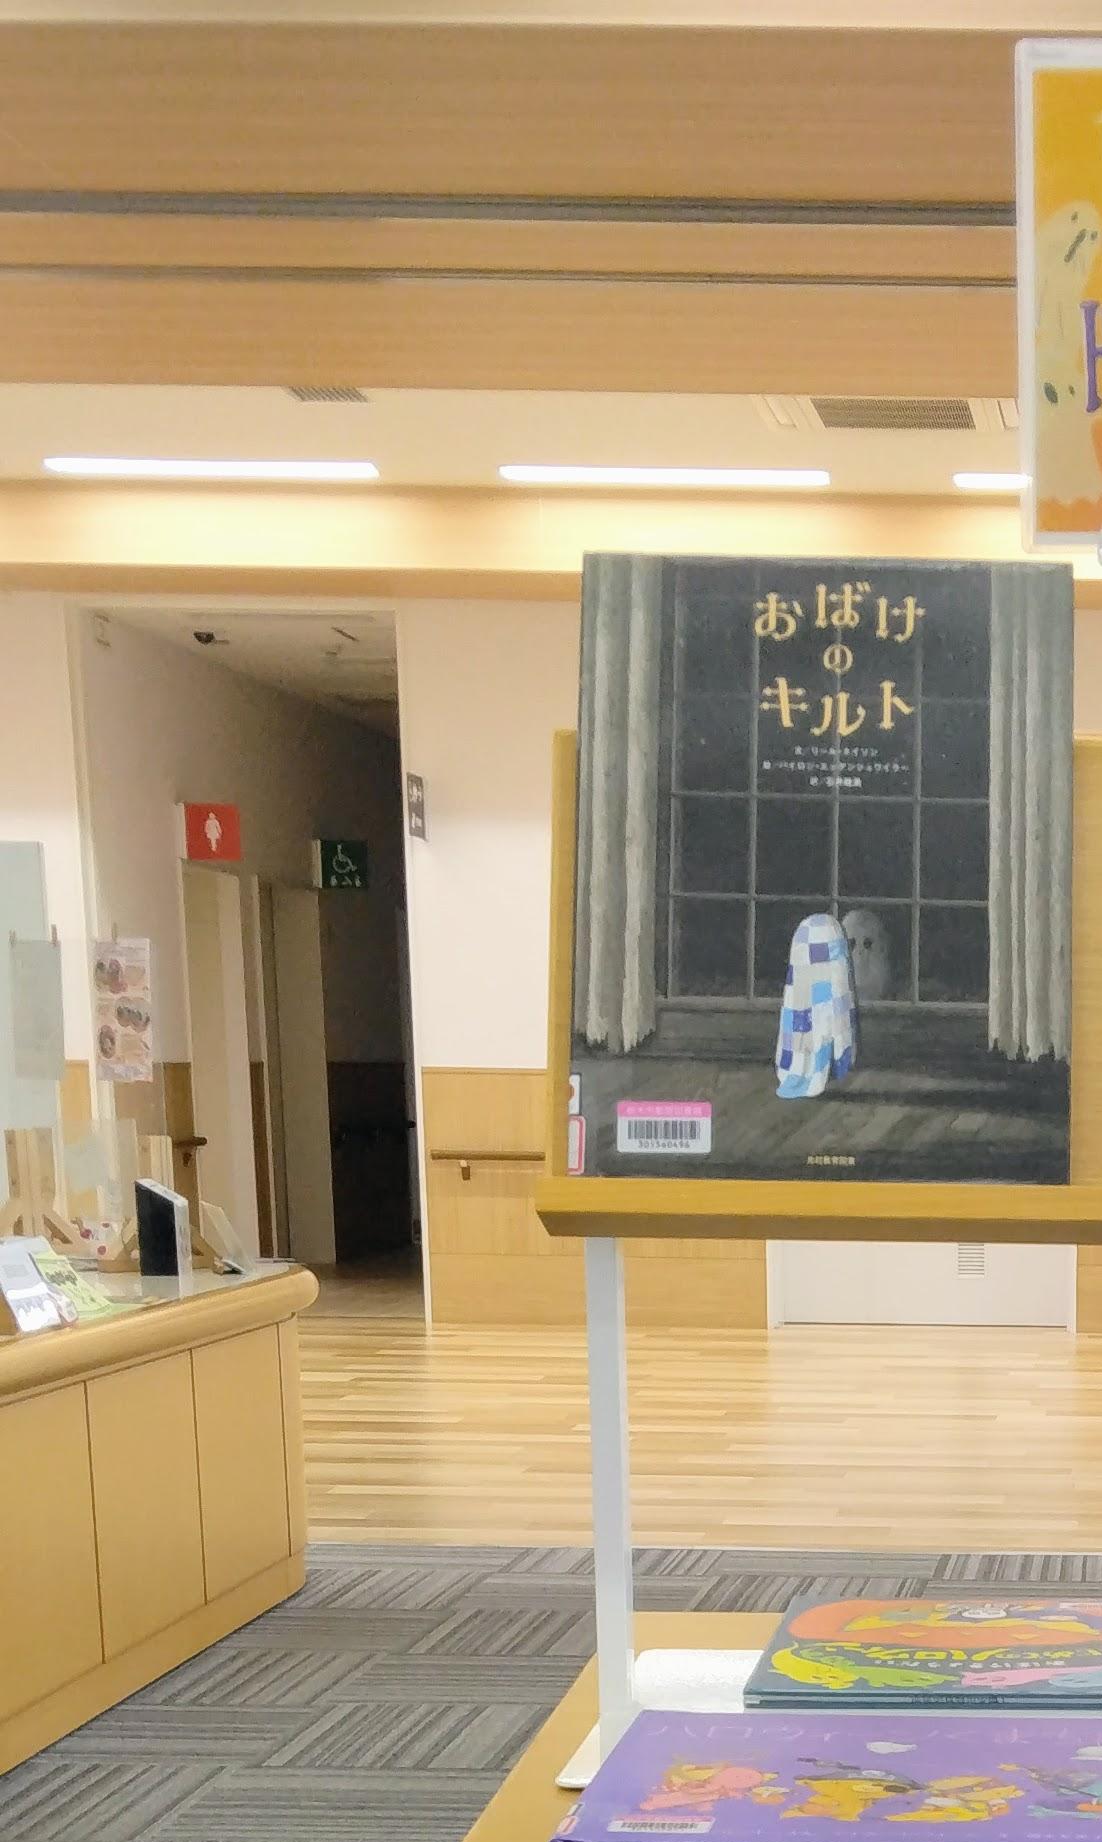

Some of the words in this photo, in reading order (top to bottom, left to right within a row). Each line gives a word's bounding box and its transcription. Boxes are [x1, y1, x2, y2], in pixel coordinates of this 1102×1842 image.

[753, 582, 925, 641] おばけ
[823, 643, 854, 672] の
[759, 676, 916, 736] キルト
